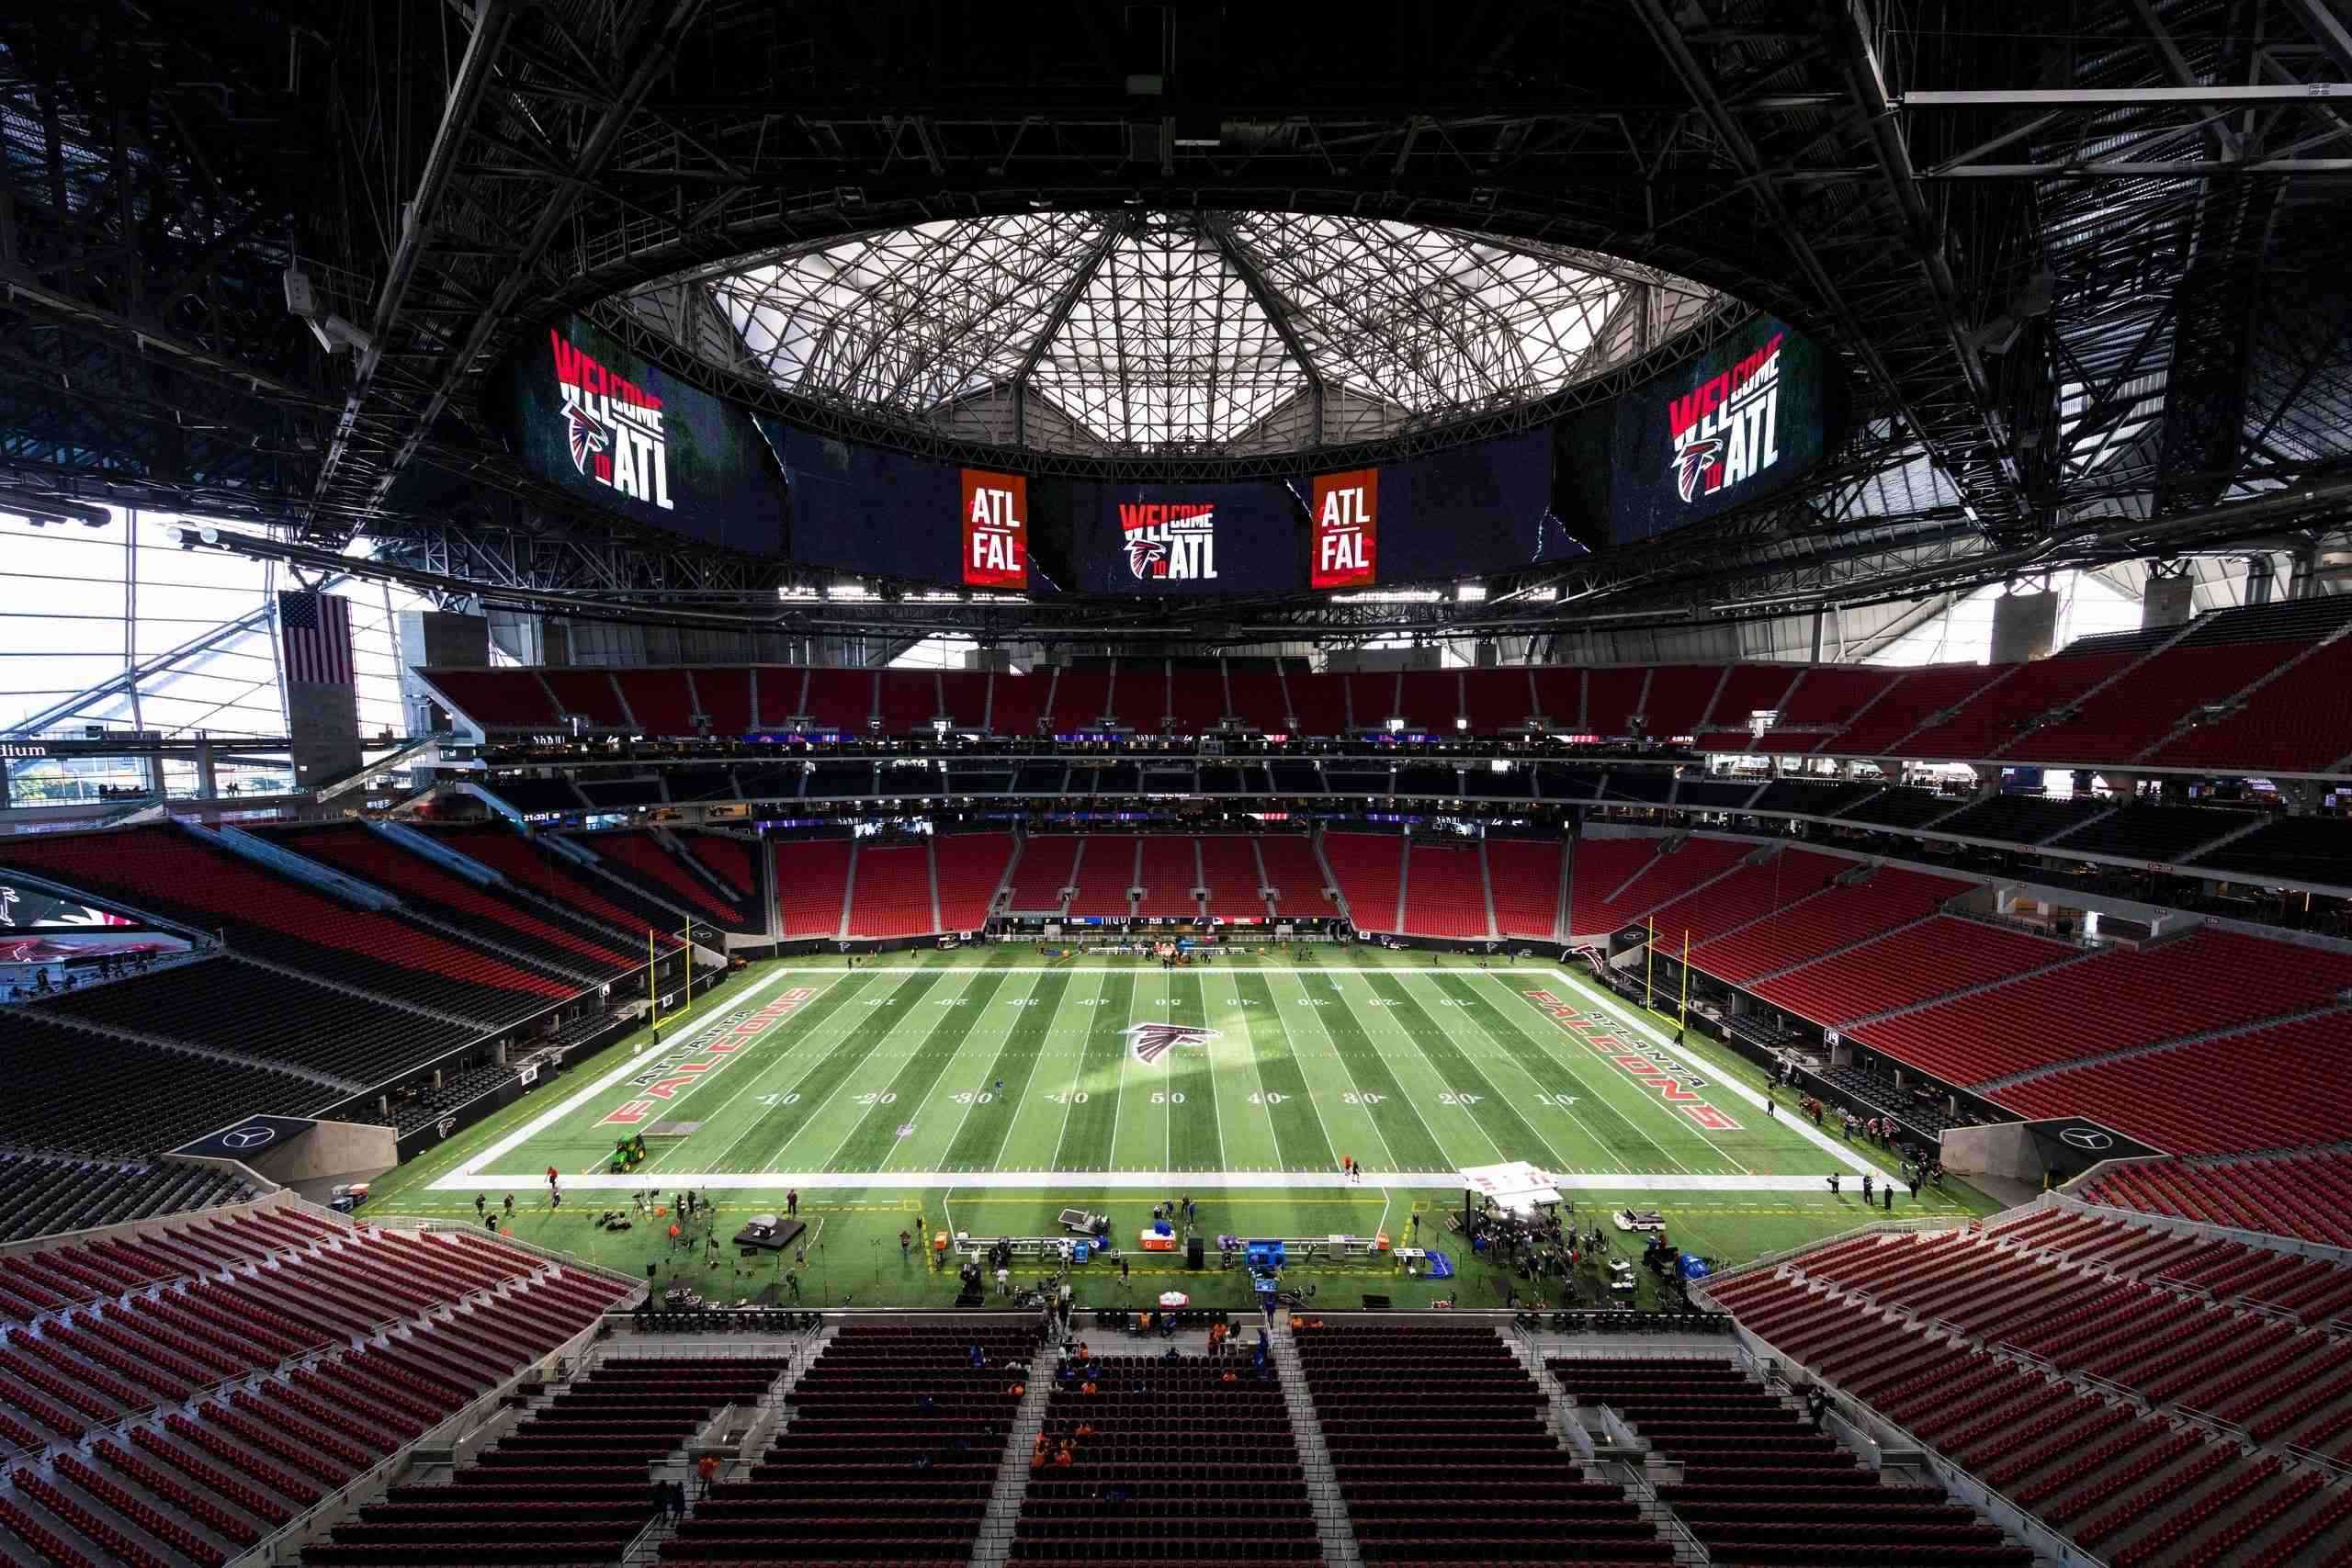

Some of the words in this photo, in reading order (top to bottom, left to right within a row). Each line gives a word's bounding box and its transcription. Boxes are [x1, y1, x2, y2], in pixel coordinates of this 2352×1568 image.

[550, 327, 664, 433] WELCOME
[1668, 333, 1783, 450] WELCOME
[1724, 388, 1779, 487] ATL
[613, 422, 673, 511] ATL
[972, 488, 1020, 527] ATL
[1119, 504, 1215, 541] WELCOME
[1321, 486, 1370, 523] ATL
[973, 531, 1021, 571] FAL
[1169, 534, 1217, 579] ATL
[1323, 530, 1369, 571] FAL
[592, 987, 819, 1129] FALCONS
[627, 1007, 752, 1087] ATLANTA
[1522, 988, 1744, 1131] FALCONS
[1587, 1010, 1707, 1088] ATLANTA
[763, 1092, 800, 1104] 10
[863, 1092, 897, 1104] 20
[956, 1092, 993, 1104] 30
[1055, 1092, 1089, 1104] 40
[1150, 1092, 1185, 1104] 50
[1248, 1092, 1283, 1104] 40
[1343, 1092, 1380, 1104] 30
[1440, 1092, 1476, 1104] 20
[1535, 1092, 1574, 1104] 10
